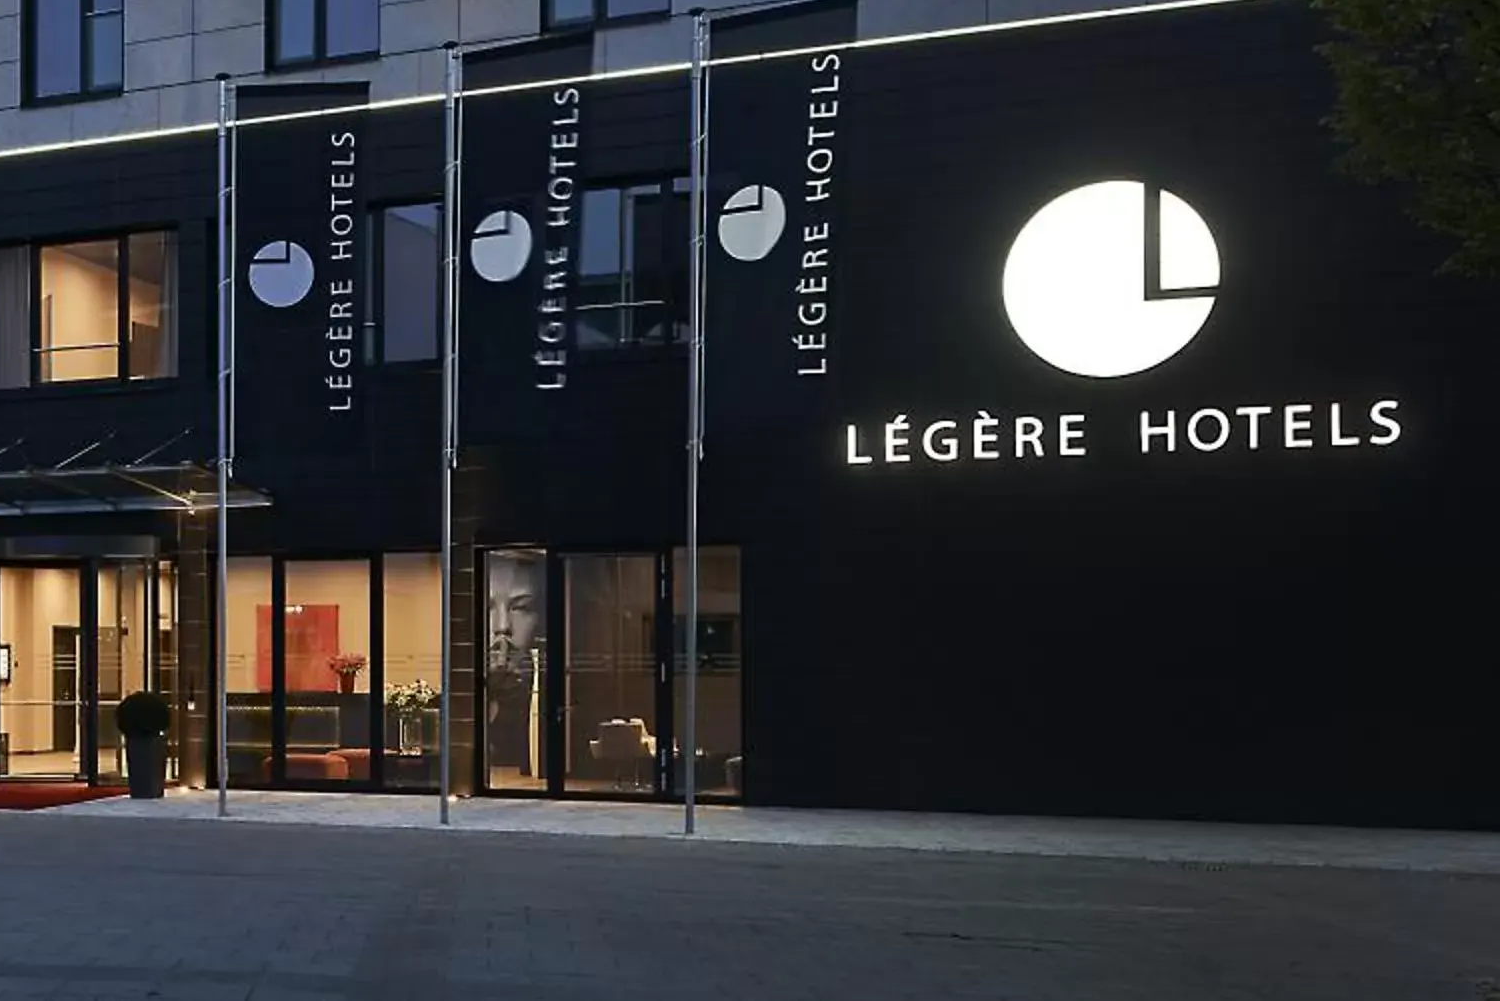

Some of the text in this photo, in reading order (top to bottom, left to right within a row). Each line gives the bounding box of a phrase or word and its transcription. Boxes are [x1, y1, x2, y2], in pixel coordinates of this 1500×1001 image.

[325, 131, 356, 411] LÉGÈRE HOTELS
[534, 86, 580, 390] LÉGÈRE HOTELS
[792, 52, 841, 376] LÉGÈRE HOTELS
[846, 399, 1402, 465] LÉGÈRE HOTELS
